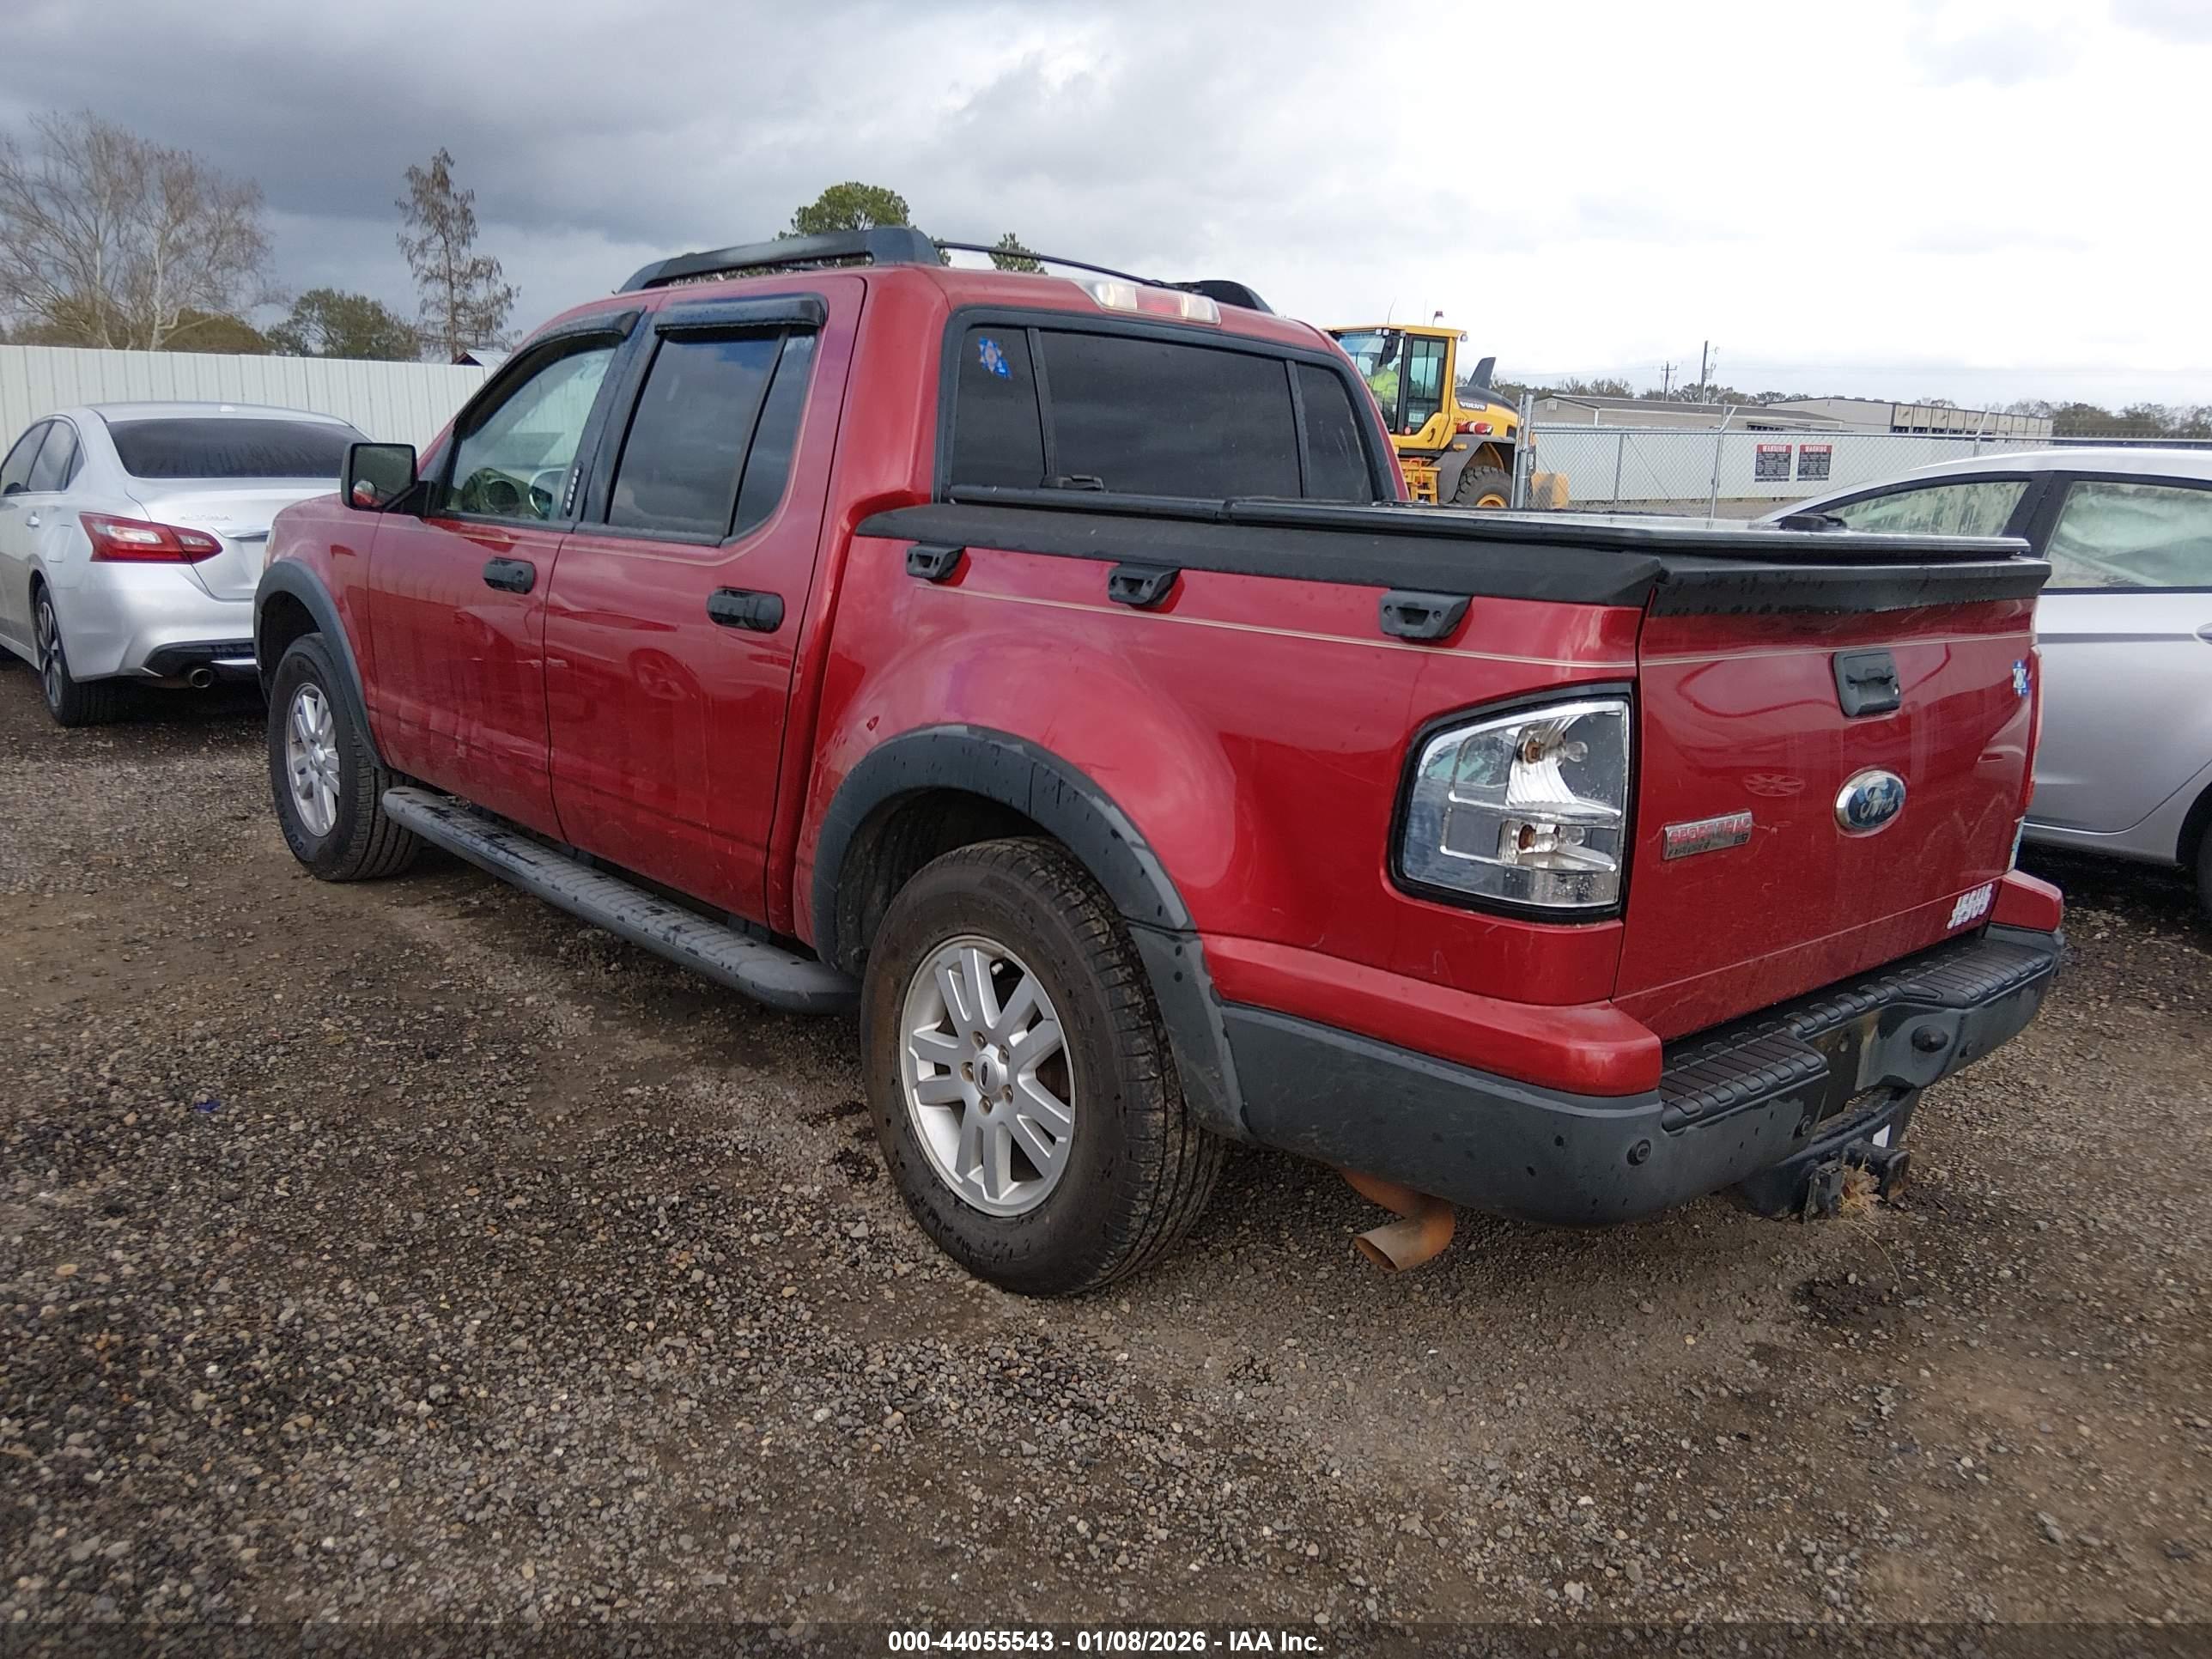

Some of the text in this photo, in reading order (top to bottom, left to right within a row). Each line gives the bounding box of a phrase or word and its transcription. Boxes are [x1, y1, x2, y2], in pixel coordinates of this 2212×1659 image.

[1460, 401, 1486, 410] VOLVO
[1859, 782, 1897, 819] Ford
[1668, 823, 1716, 843] SPORT
